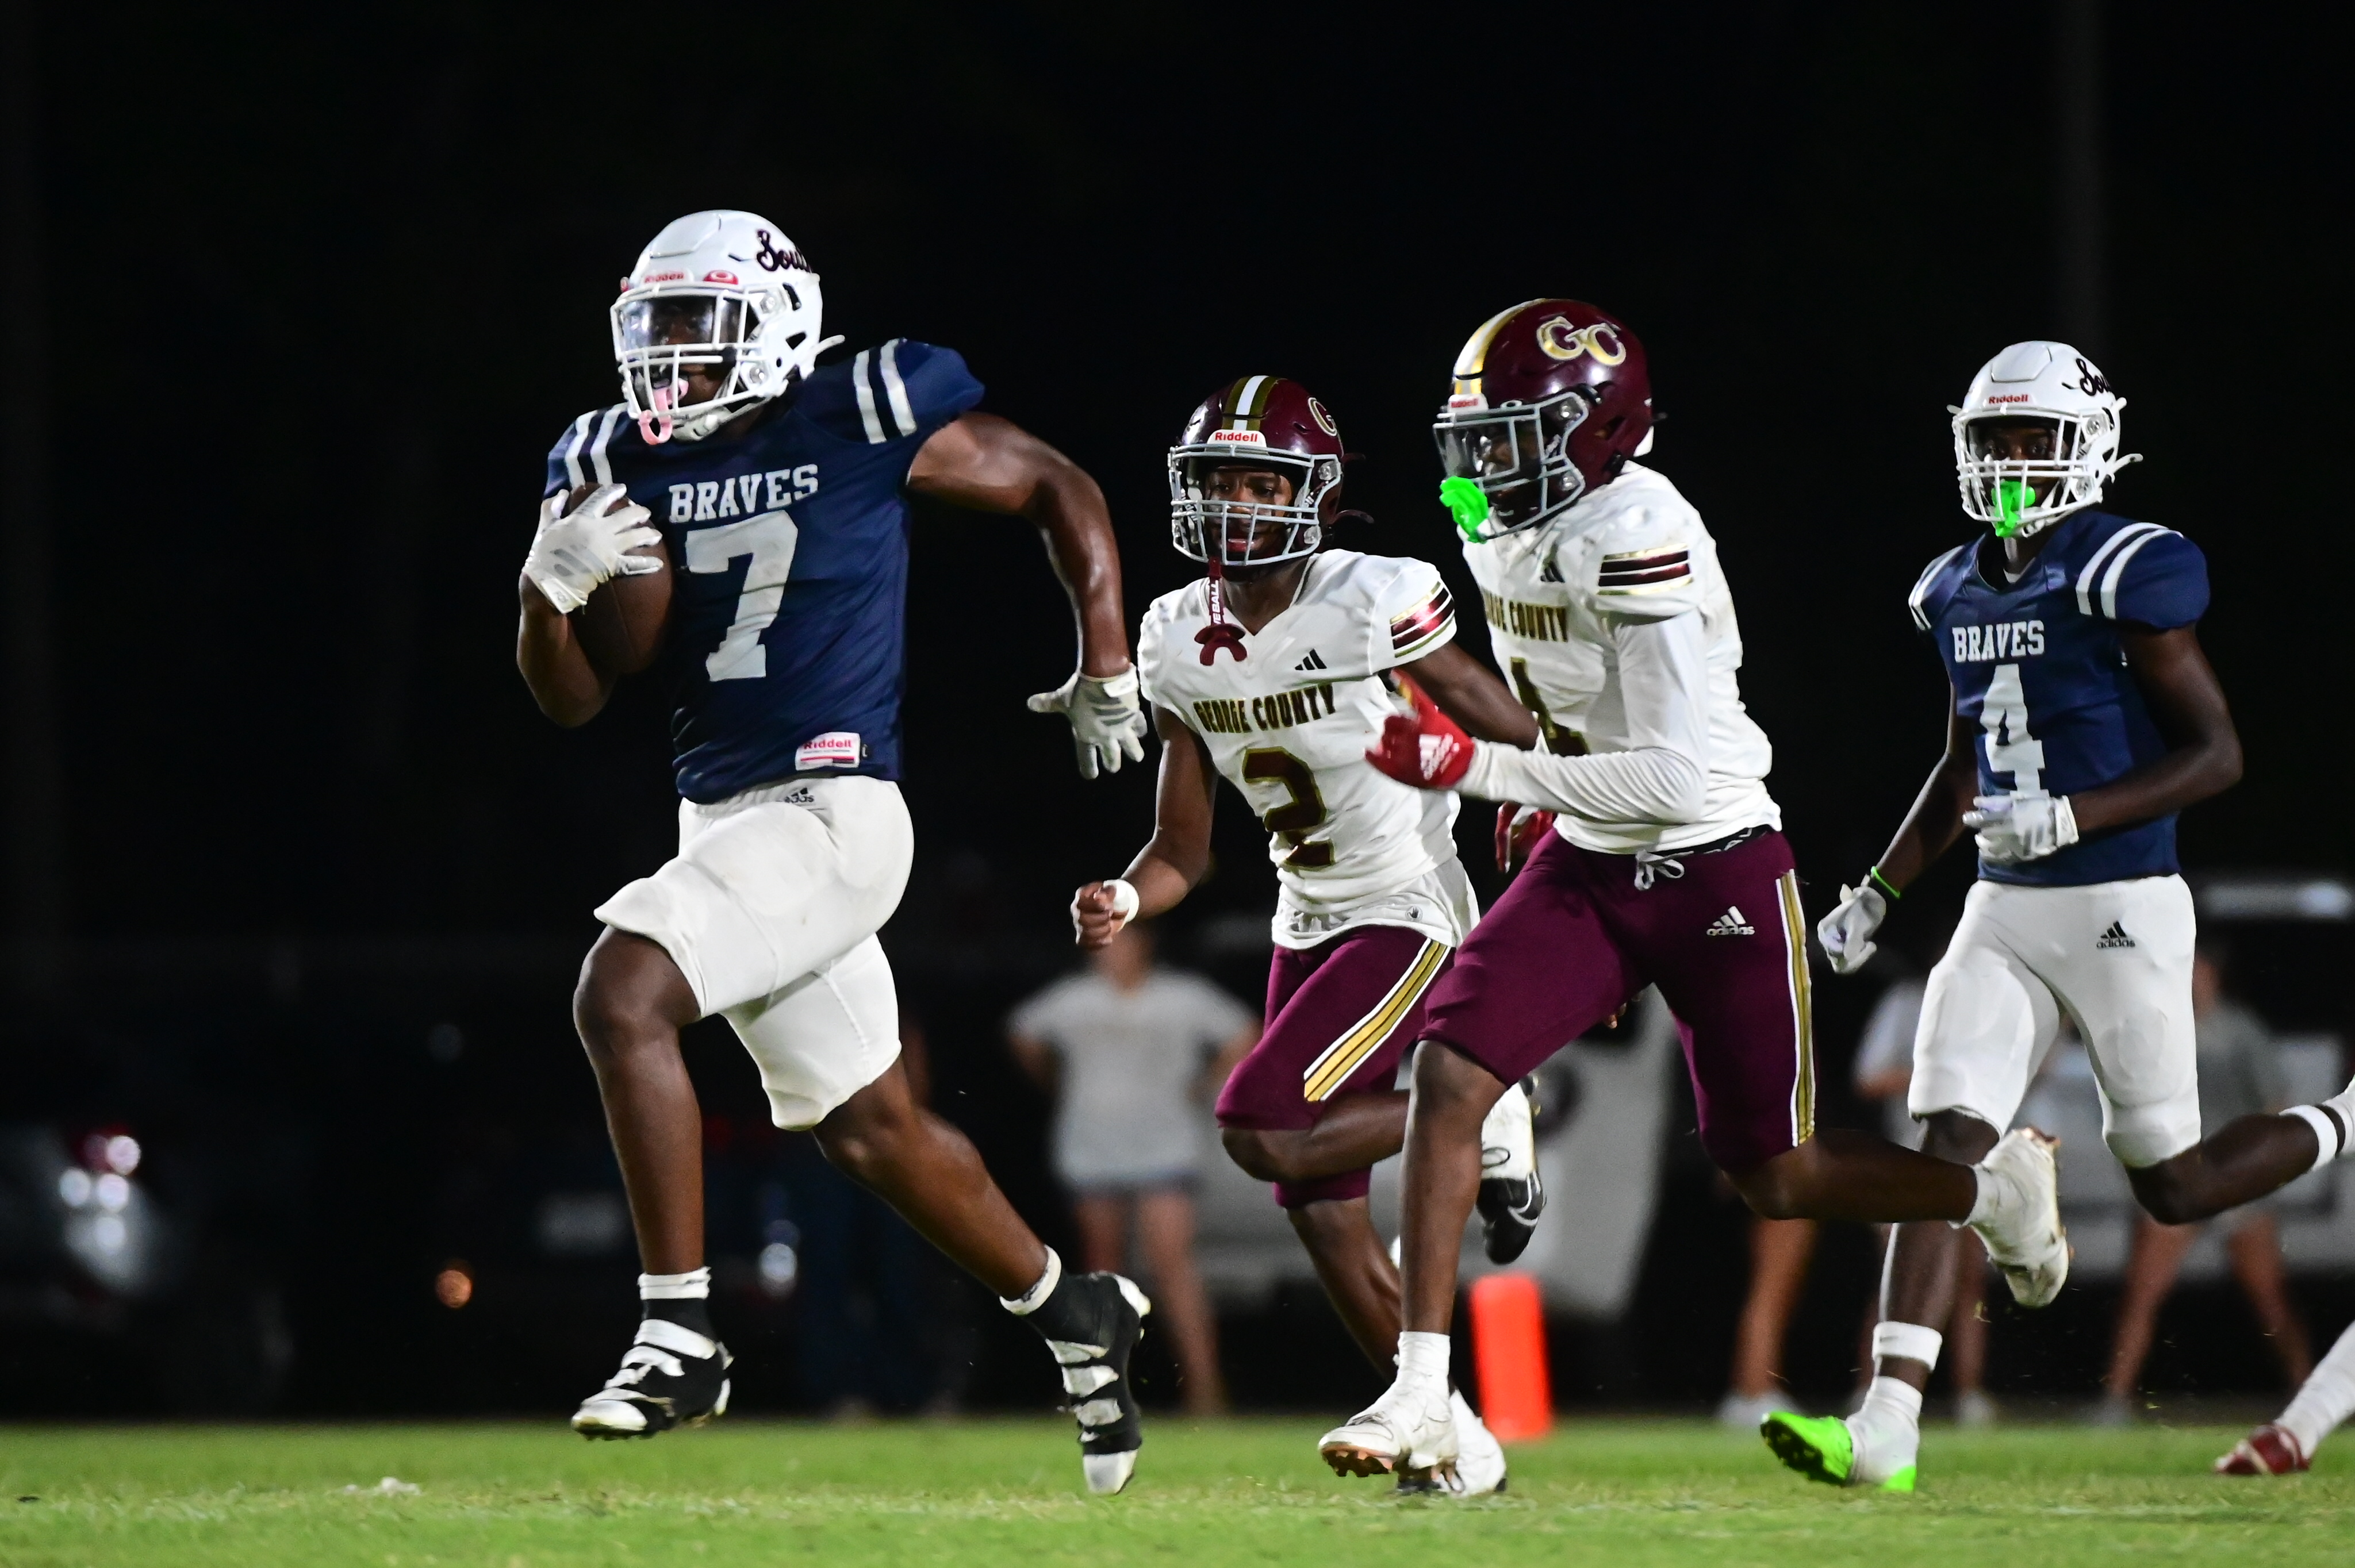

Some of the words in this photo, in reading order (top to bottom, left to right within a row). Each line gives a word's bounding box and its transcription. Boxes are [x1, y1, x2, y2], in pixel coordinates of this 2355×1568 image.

[1536, 316, 1626, 366] GC
[1308, 397, 1340, 437] G
[1988, 394, 2028, 404] Riddell
[1215, 432, 1258, 443] Riddell
[669, 464, 819, 523] BRAVES
[685, 510, 799, 682] 7
[1952, 620, 2045, 663] BRAVES
[1252, 682, 1336, 732] COUNTY
[804, 739, 852, 750] Riddell
[1980, 663, 2049, 798] 4
[1242, 746, 1335, 868] 2
[1706, 925, 1755, 936] adidas
[2096, 937, 2135, 948] adidas
